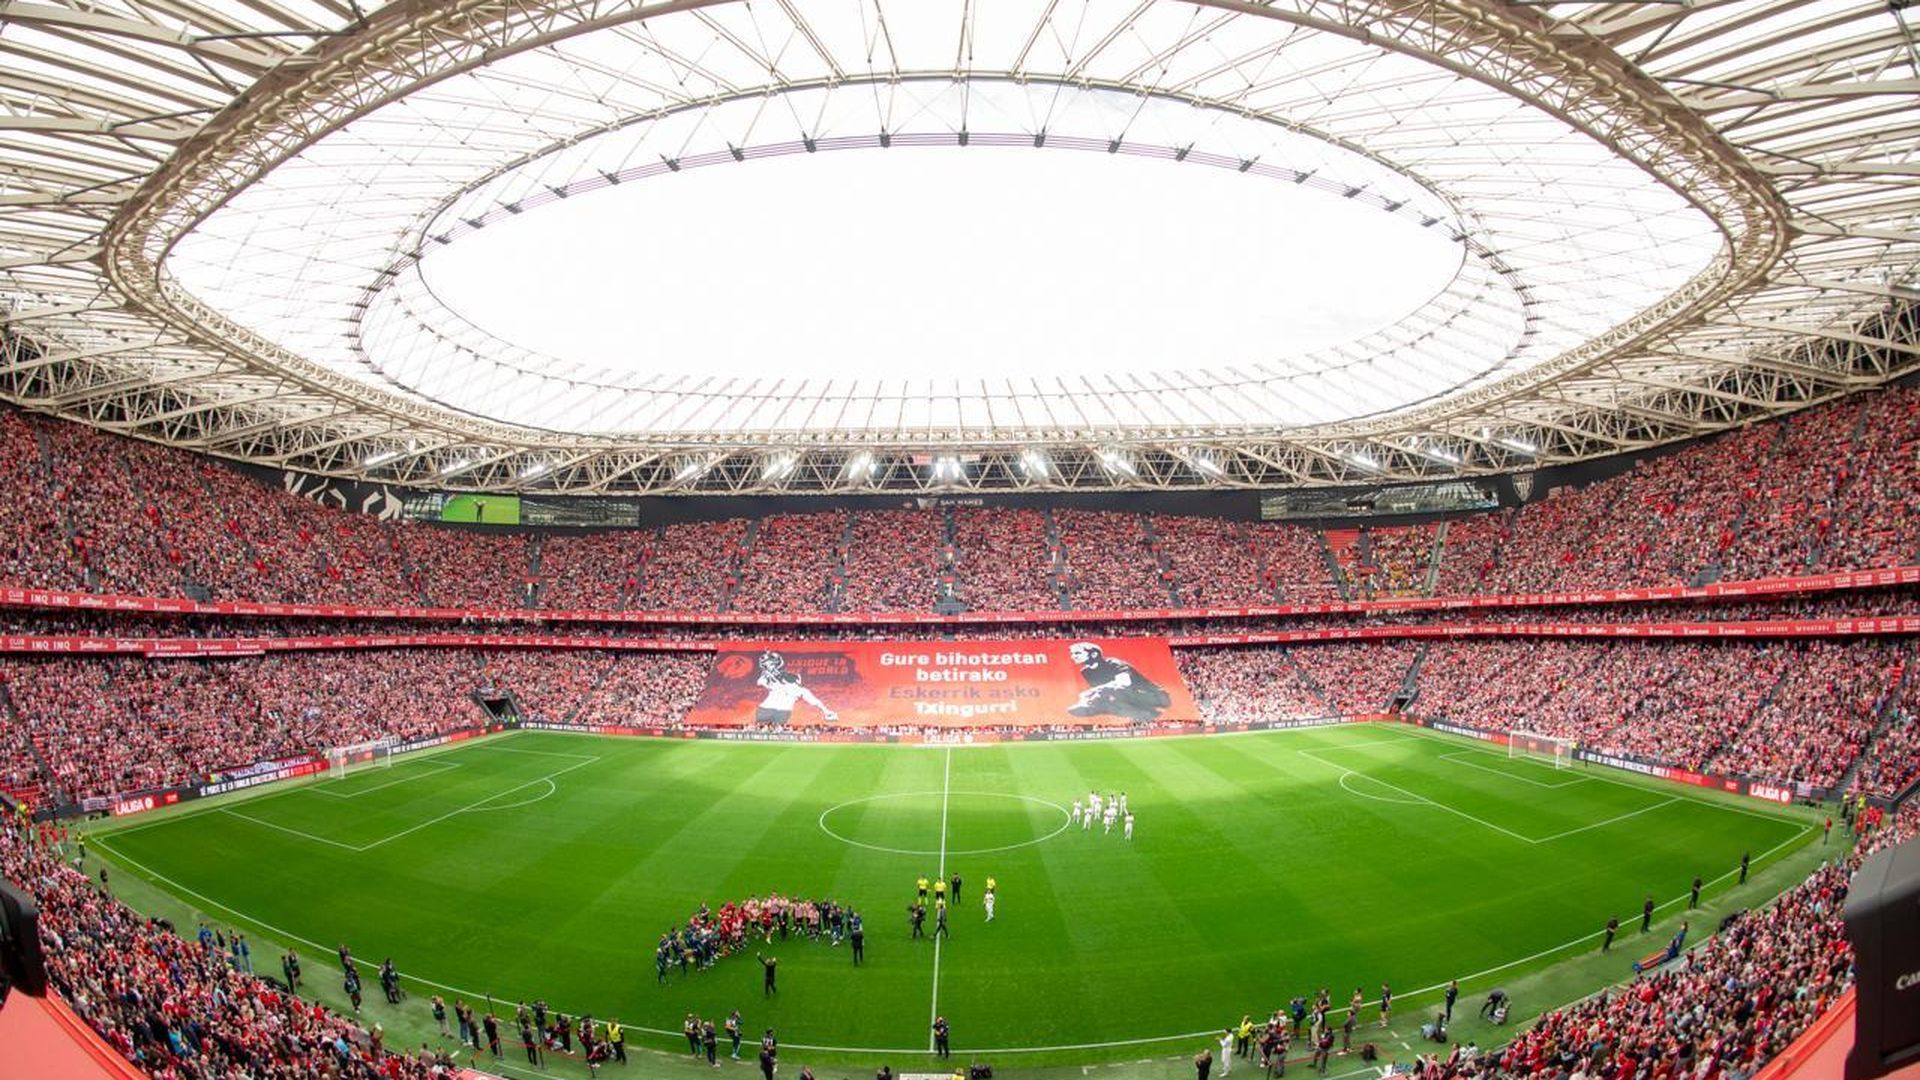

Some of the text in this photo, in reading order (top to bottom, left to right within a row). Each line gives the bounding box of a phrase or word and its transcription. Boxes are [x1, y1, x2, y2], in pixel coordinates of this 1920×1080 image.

[880, 652, 1048, 665] Gure bihotzetan
[808, 666, 849, 676] WORLD
[916, 668, 1008, 682] betirako
[890, 685, 1040, 699] Eskerrik asko
[1750, 784, 1779, 800] LALIGA
[116, 798, 144, 815] LALIGA
